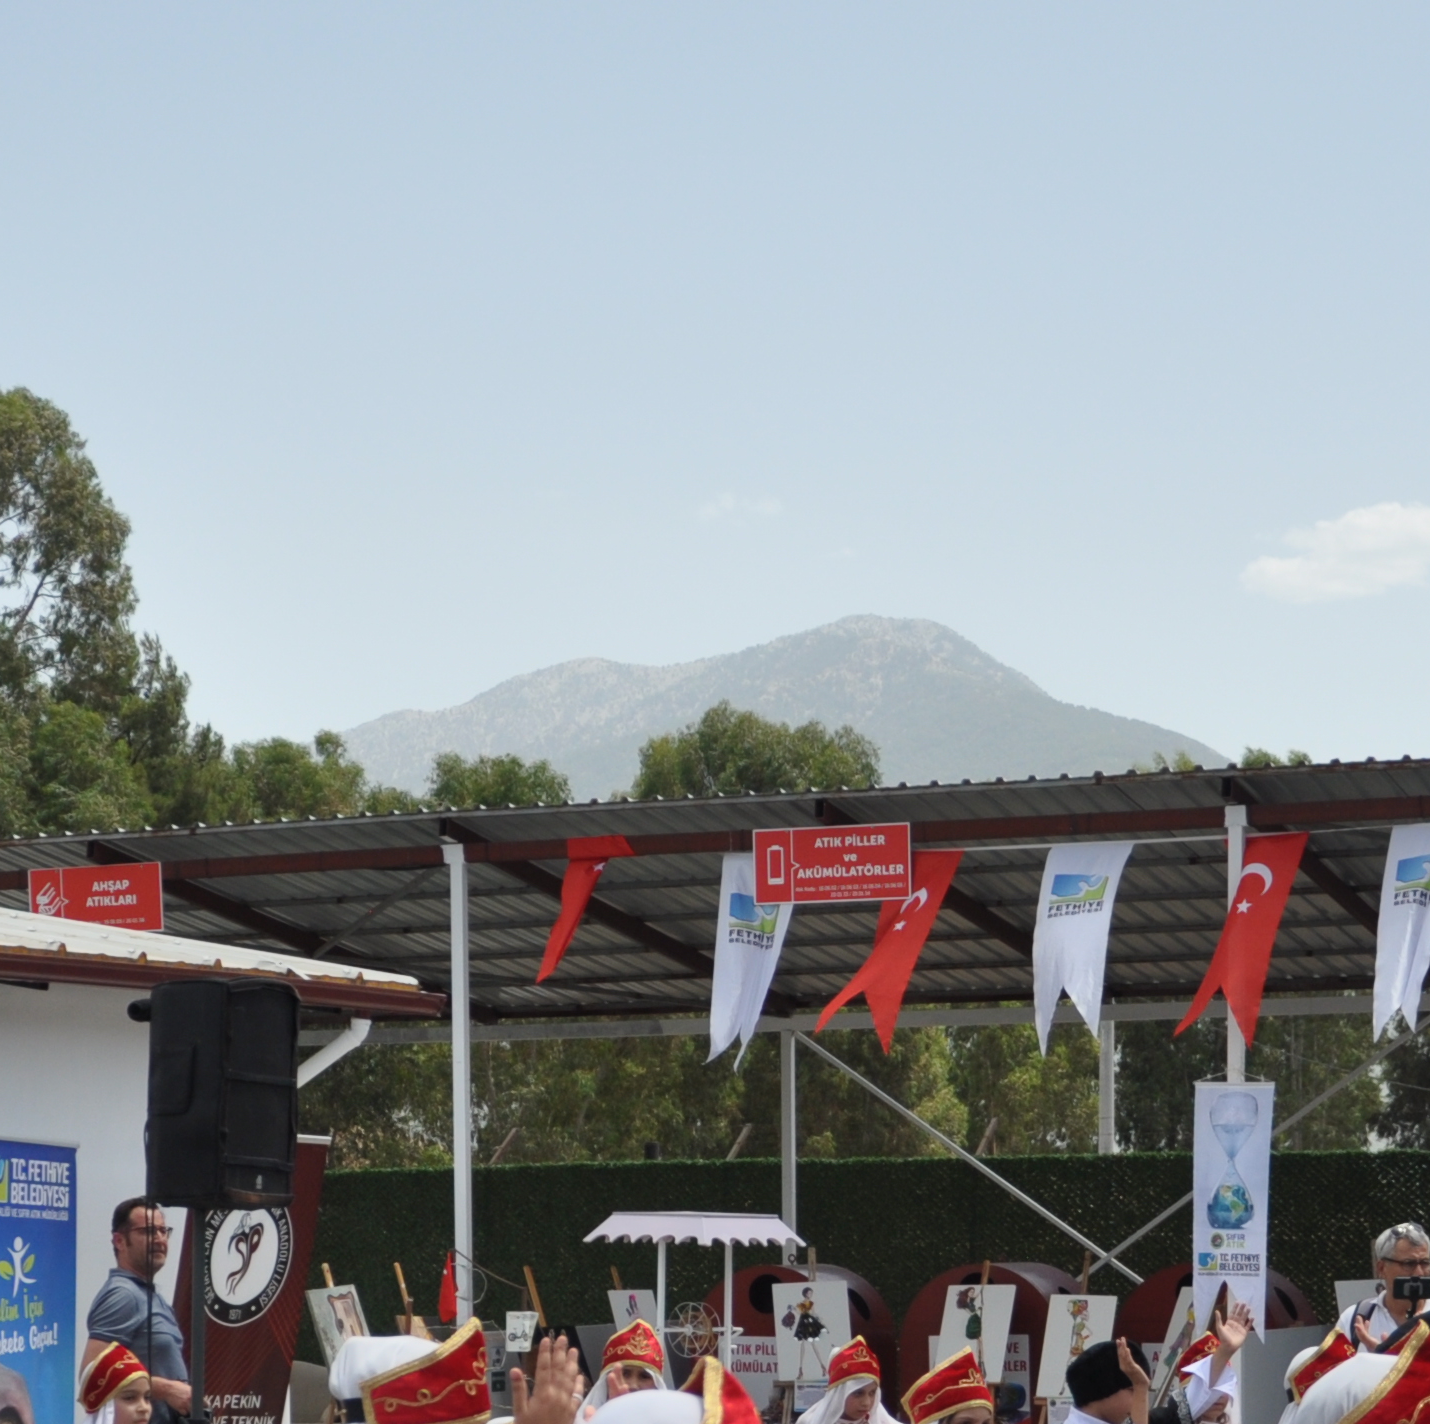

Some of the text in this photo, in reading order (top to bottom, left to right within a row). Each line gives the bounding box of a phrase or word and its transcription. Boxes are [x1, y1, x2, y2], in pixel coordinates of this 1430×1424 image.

[814, 833, 885, 848] ATIK PİLLER
[843, 853, 857, 862] ve
[797, 863, 904, 879] AKÜMÜLATÖRLER
[92, 880, 130, 893] AHŞAP
[86, 894, 137, 907] ATIKLARI
[23, 1288, 44, 1324] İçin
[29, 1322, 58, 1353] Geçin!
[223, 1391, 262, 1409] PEKİN
